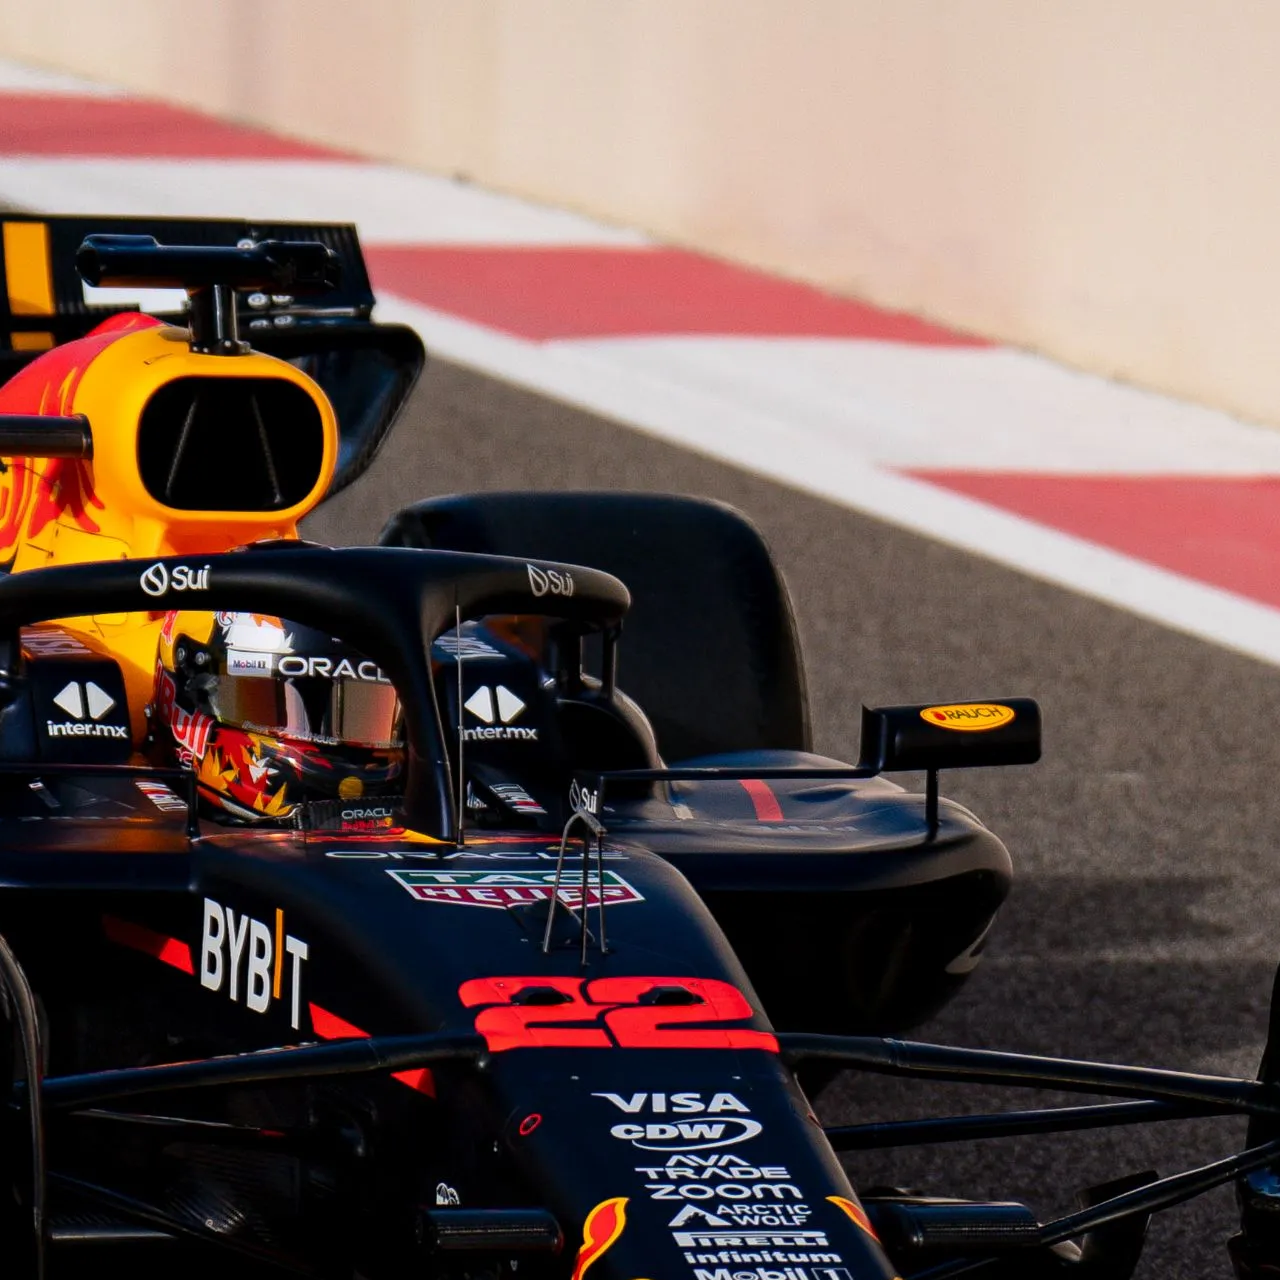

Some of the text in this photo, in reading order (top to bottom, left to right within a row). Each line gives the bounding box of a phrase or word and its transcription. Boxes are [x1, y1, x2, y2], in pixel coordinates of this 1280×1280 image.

[171, 565, 211, 590] Sui
[546, 570, 574, 596] Sui
[232, 659, 257, 669] Mobil
[278, 656, 393, 682] ORACL
[946, 706, 1004, 721] RAUCH
[47, 720, 128, 739] inter.mx
[460, 726, 538, 741] inter.mx
[581, 789, 598, 813] Sui
[341, 807, 393, 820] ORACL
[325, 851, 631, 860] ORACLE
[407, 873, 601, 884] TAG
[421, 886, 629, 905] HEUER
[458, 976, 780, 1052] 22
[591, 1092, 751, 1113] VISA
[610, 1124, 726, 1139] CDW
[665, 1154, 751, 1166] AVA
[634, 1166, 792, 1179] TRADE
[716, 1203, 813, 1215] ARCTIC
[732, 1215, 808, 1226] WOLF
[672, 1231, 829, 1247] PIRELLI
[683, 1252, 842, 1264] infinitum
